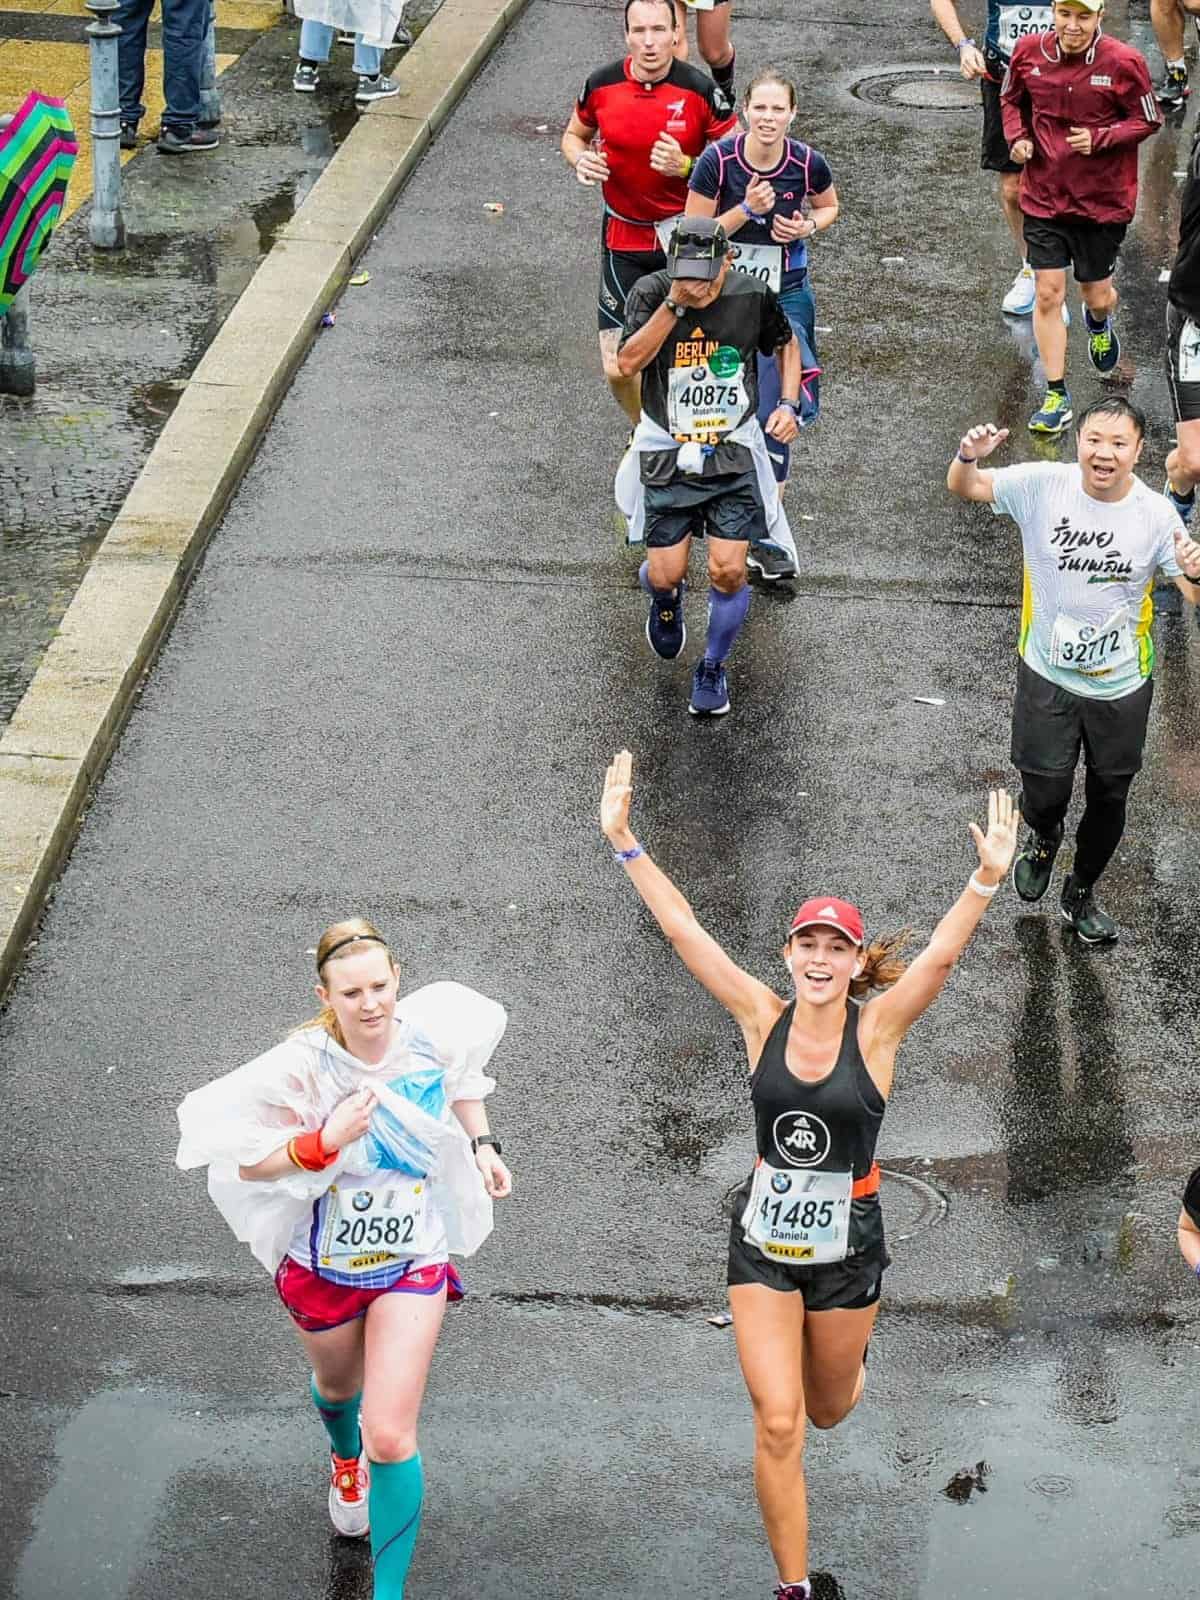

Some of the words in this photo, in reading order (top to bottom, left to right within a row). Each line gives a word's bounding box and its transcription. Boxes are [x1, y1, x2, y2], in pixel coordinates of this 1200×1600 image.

[676, 341, 719, 359] BERLIN
[679, 385, 738, 407] 40875
[1062, 630, 1120, 662] 32772
[760, 1197, 834, 1229] 41485
[336, 1215, 414, 1246] 20582
[771, 1229, 809, 1241] Daniela
